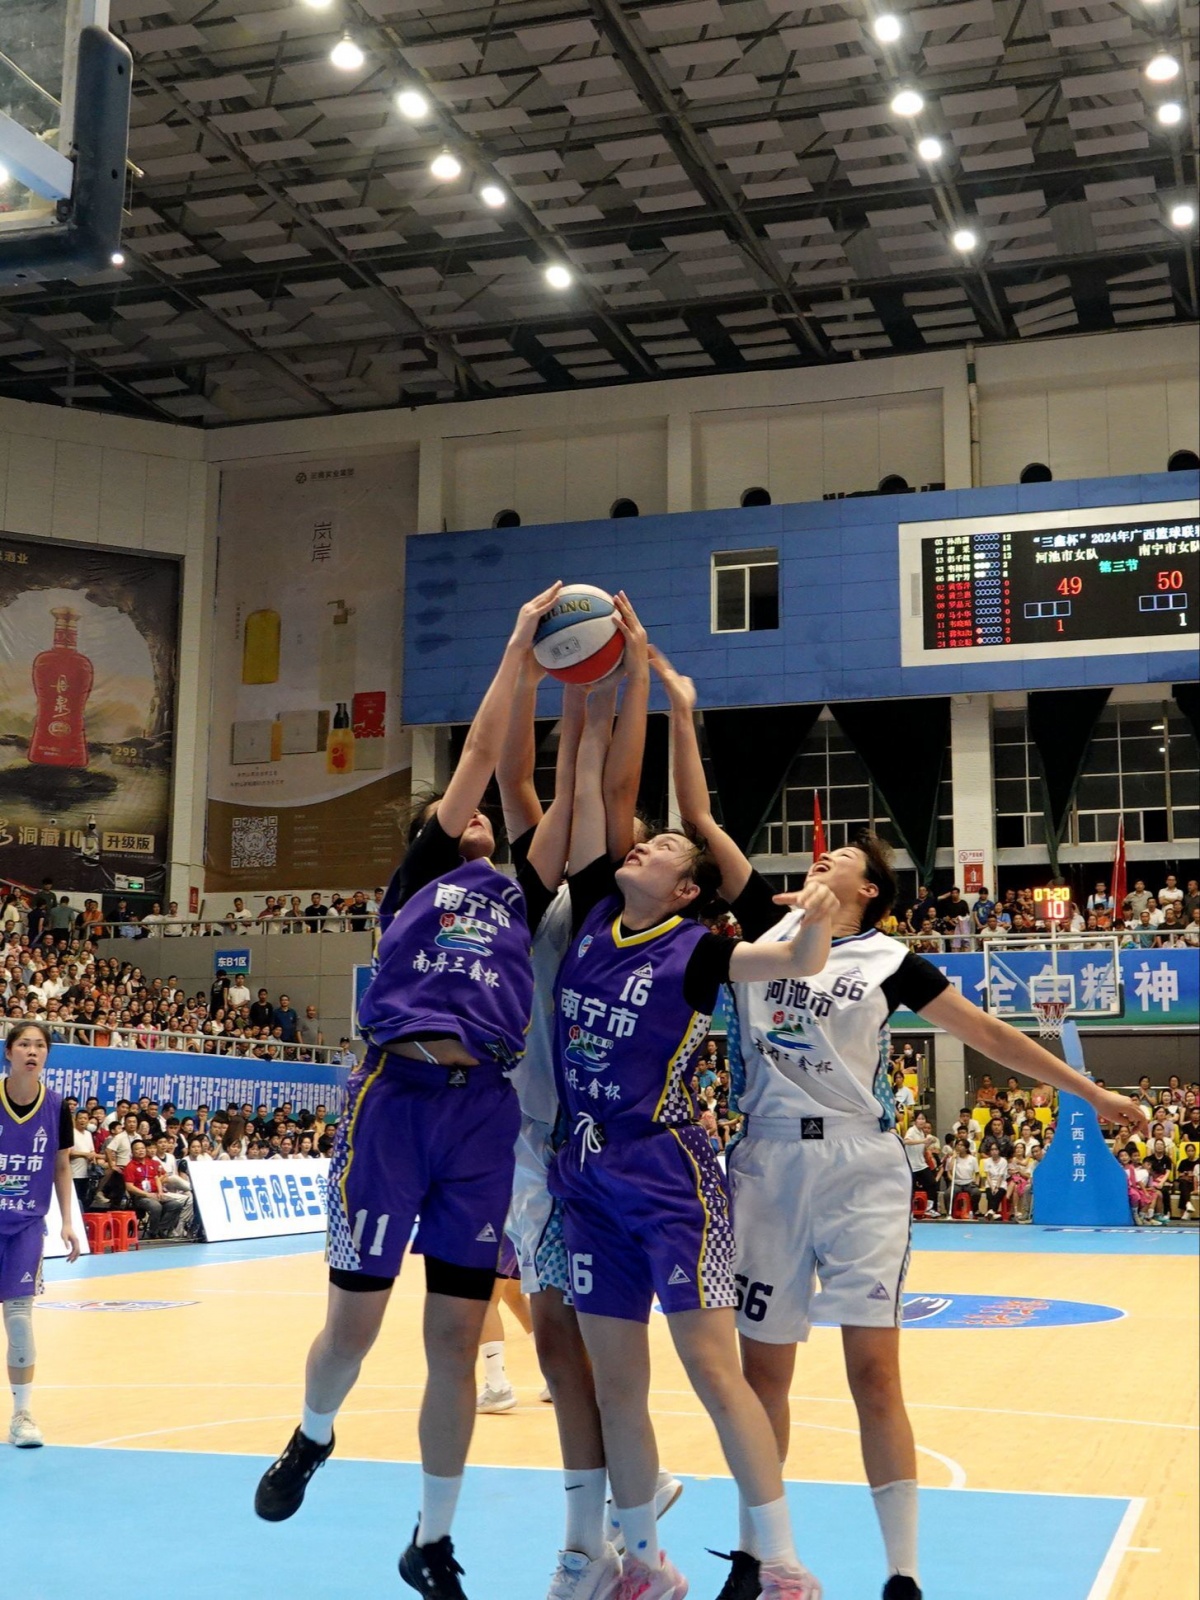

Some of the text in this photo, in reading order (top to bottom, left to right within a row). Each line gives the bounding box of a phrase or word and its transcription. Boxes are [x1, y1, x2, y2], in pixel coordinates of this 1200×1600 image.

[0, 550, 29, 565] 酒业
[1035, 547, 1099, 564] 河池市女队
[1099, 558, 1139, 574] 第三节
[1057, 570, 1184, 596] 49 50
[1056, 612, 1187, 632] 1 1
[107, 834, 150, 850] 升级版
[1033, 887, 1070, 902] 07:20
[434, 882, 511, 928] 南宁市
[1047, 900, 1065, 918] 10
[218, 957, 247, 967] 东B1区
[412, 949, 500, 988] 南丹三鑫杯
[619, 976, 653, 1007] 16
[764, 978, 835, 1017] 河池市
[831, 976, 868, 1001] 66
[561, 988, 639, 1038] 南宁市
[33, 1137, 48, 1153] 17
[353, 1208, 390, 1257] 11
